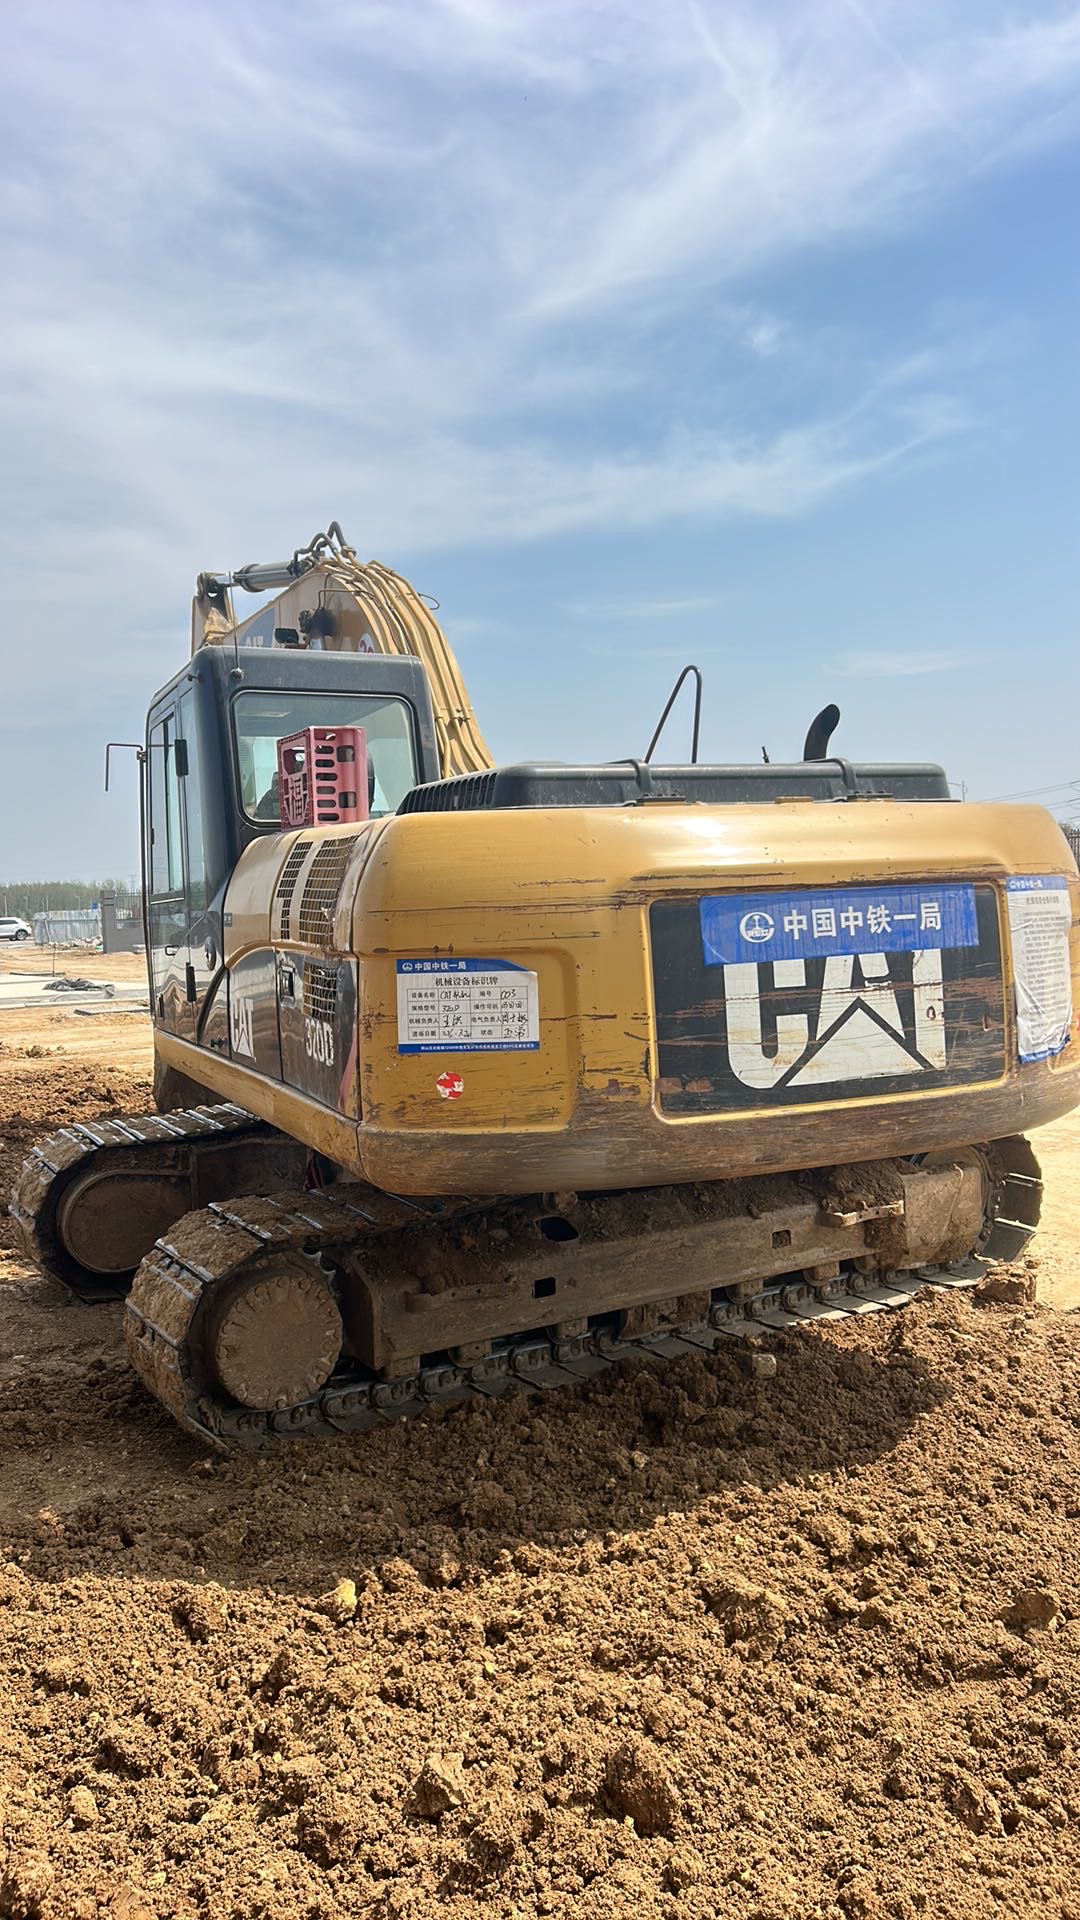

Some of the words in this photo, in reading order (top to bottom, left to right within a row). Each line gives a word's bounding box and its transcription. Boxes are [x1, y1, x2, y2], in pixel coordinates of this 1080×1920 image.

[783, 902, 942, 941] 中国中铁一局
[414, 961, 467, 971] 中国中铁一局
[435, 976, 498, 987] 机械设备标识牌
[230, 997, 257, 1062] CAT
[305, 1018, 335, 1067] 320D
